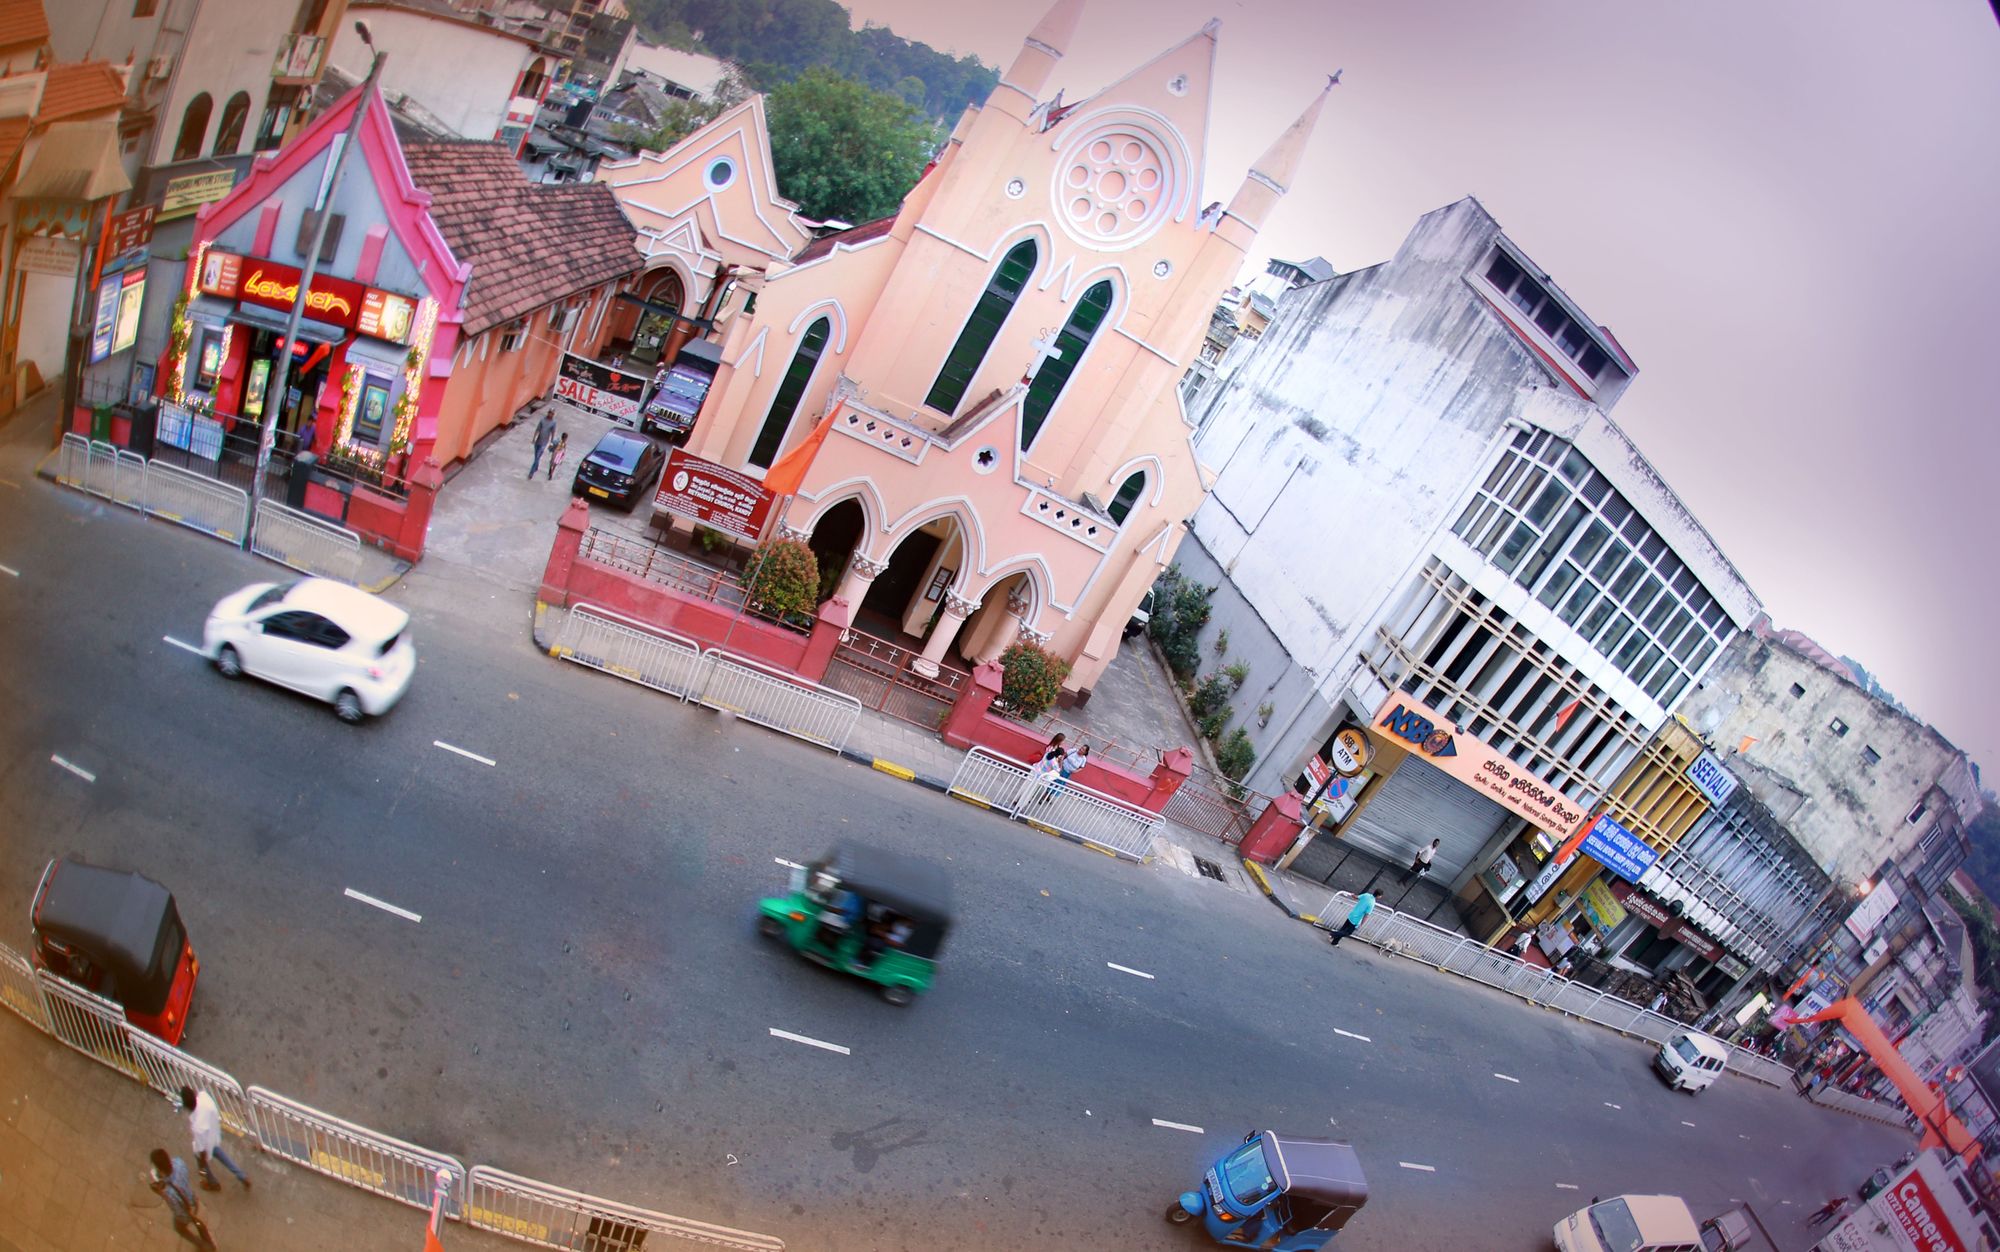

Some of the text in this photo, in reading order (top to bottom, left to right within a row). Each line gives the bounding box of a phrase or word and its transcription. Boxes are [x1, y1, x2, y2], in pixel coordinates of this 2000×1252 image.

[244, 270, 351, 317] Laxan
[609, 401, 625, 412] SALE
[620, 405, 637, 416] SALE
[687, 488, 714, 503] METHODIST
[734, 506, 752, 517] KANDY
[1380, 703, 1435, 745] NSB
[1341, 733, 1355, 748] NSB
[1337, 748, 1352, 766] ATM
[1691, 757, 1732, 800] SEEVALI
[1522, 802, 1568, 835] National Savings Bank
[1586, 834, 1607, 851] SEEVALI
[1602, 844, 1617, 859] BOOK
[1613, 852, 1627, 865] SHOP
[1887, 1192, 1919, 1242] 0727 817 872
[1900, 1183, 1956, 1252] Camera
